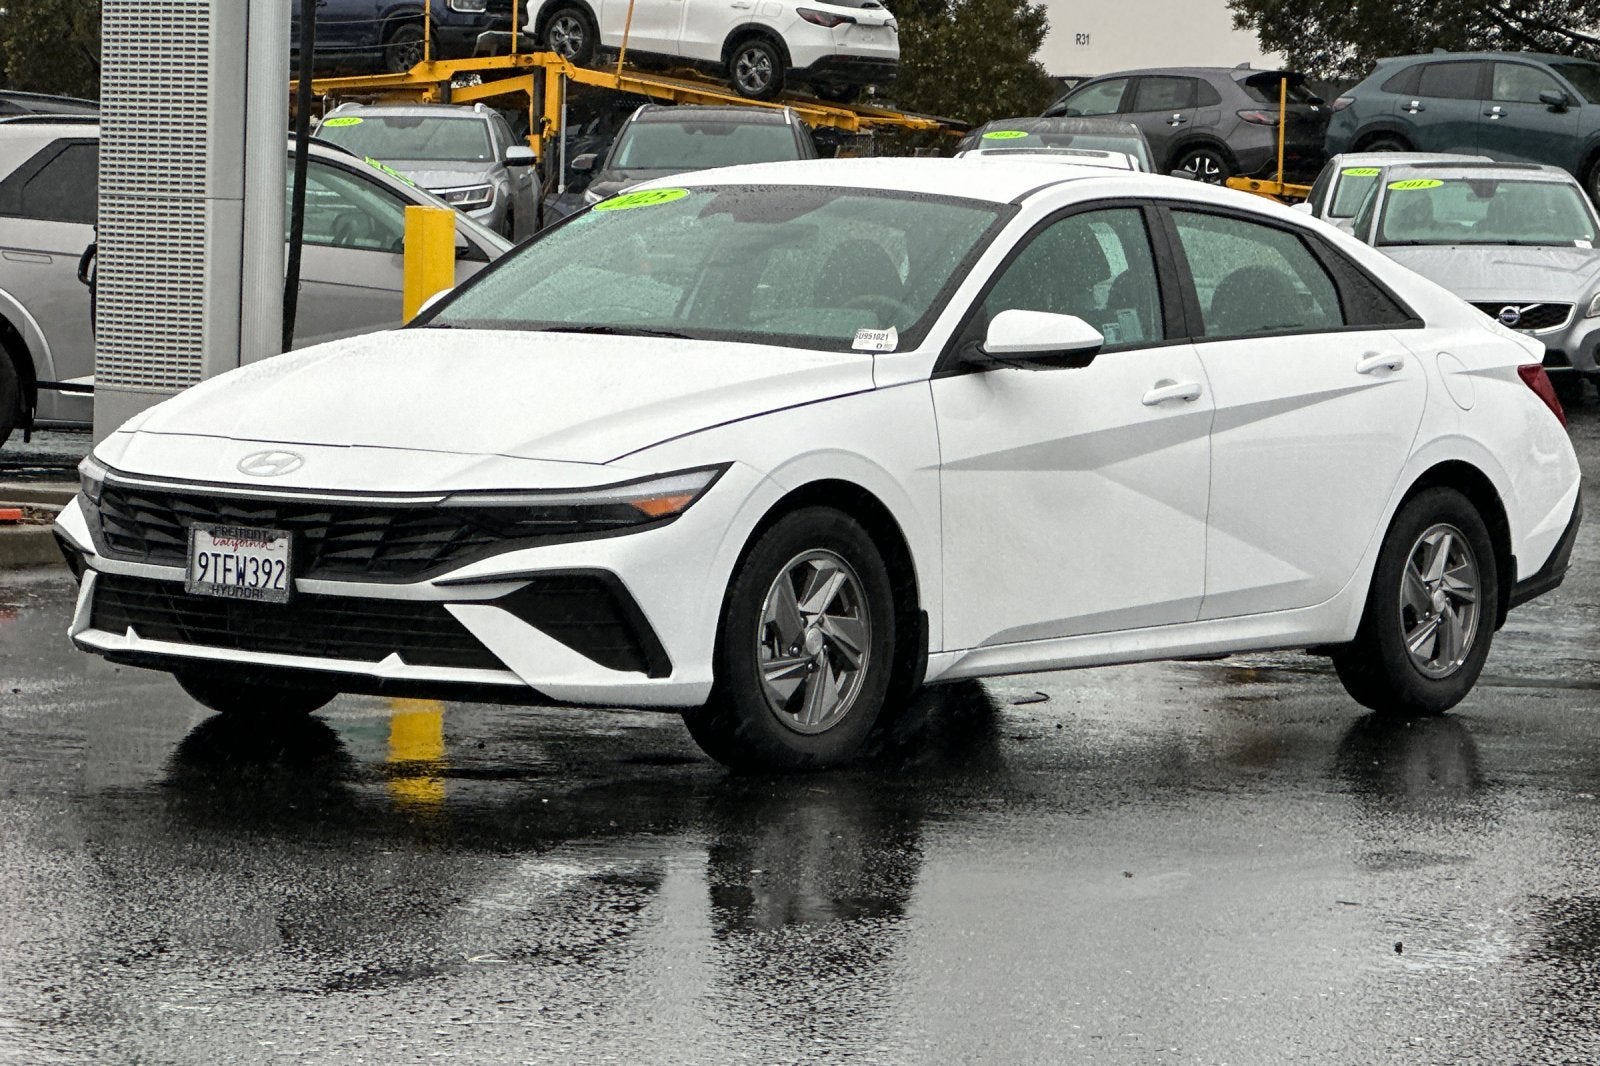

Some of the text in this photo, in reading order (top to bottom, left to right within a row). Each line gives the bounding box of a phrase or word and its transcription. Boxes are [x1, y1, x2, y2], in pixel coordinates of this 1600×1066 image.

[1076, 33, 1090, 46] R31
[214, 526, 268, 539] FREMONT
[212, 536, 274, 552] California
[197, 552, 286, 591] 9TFW392
[211, 583, 264, 599] HYUNDAI
